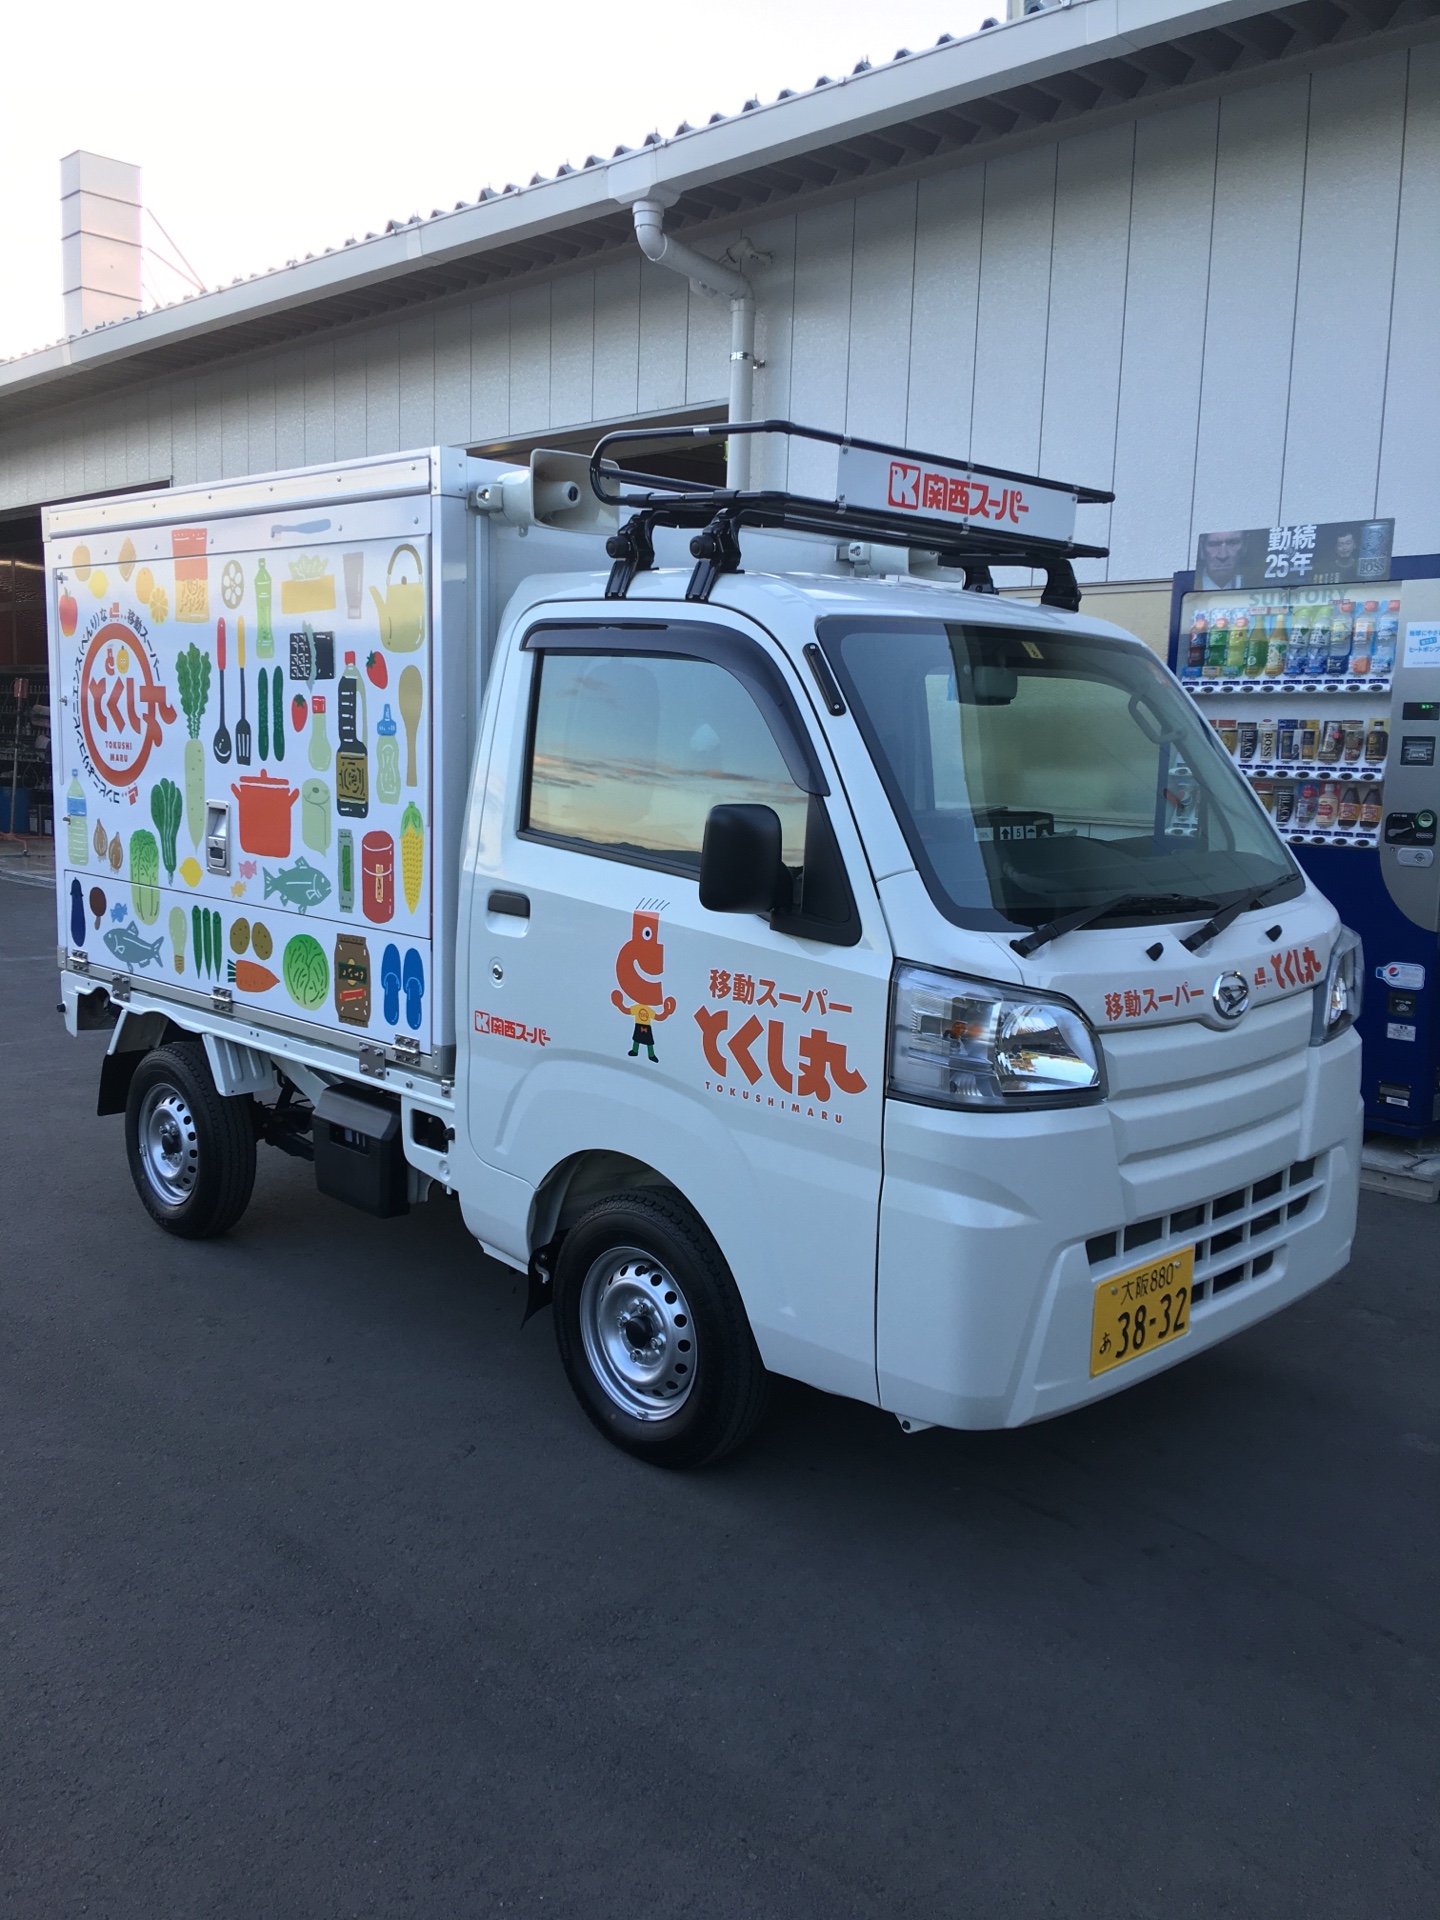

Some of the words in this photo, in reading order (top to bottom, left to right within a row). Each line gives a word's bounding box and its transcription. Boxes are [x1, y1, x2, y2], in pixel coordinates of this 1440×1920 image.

[922, 473, 1029, 524] 関西スーパー
[1267, 525, 1318, 552] 勤続
[1264, 552, 1314, 579] 25年
[1359, 560, 1385, 573] BOSS
[88, 676, 178, 748] とくし丸
[105, 740, 132, 750] TOKUSHI
[109, 753, 129, 762] MARU
[1263, 732, 1273, 757] BOSS
[1270, 946, 1322, 989] とくし丸
[709, 968, 853, 1016] 移動スーパー
[1104, 981, 1205, 1021] 移動スーパー
[491, 1017, 551, 1046] 関西スーパー
[693, 1004, 868, 1102] とくし丸
[705, 1080, 843, 1124] TOKUSHIMARU
[1099, 1332, 1112, 1355] あ
[1115, 1287, 1188, 1359] 38-32
